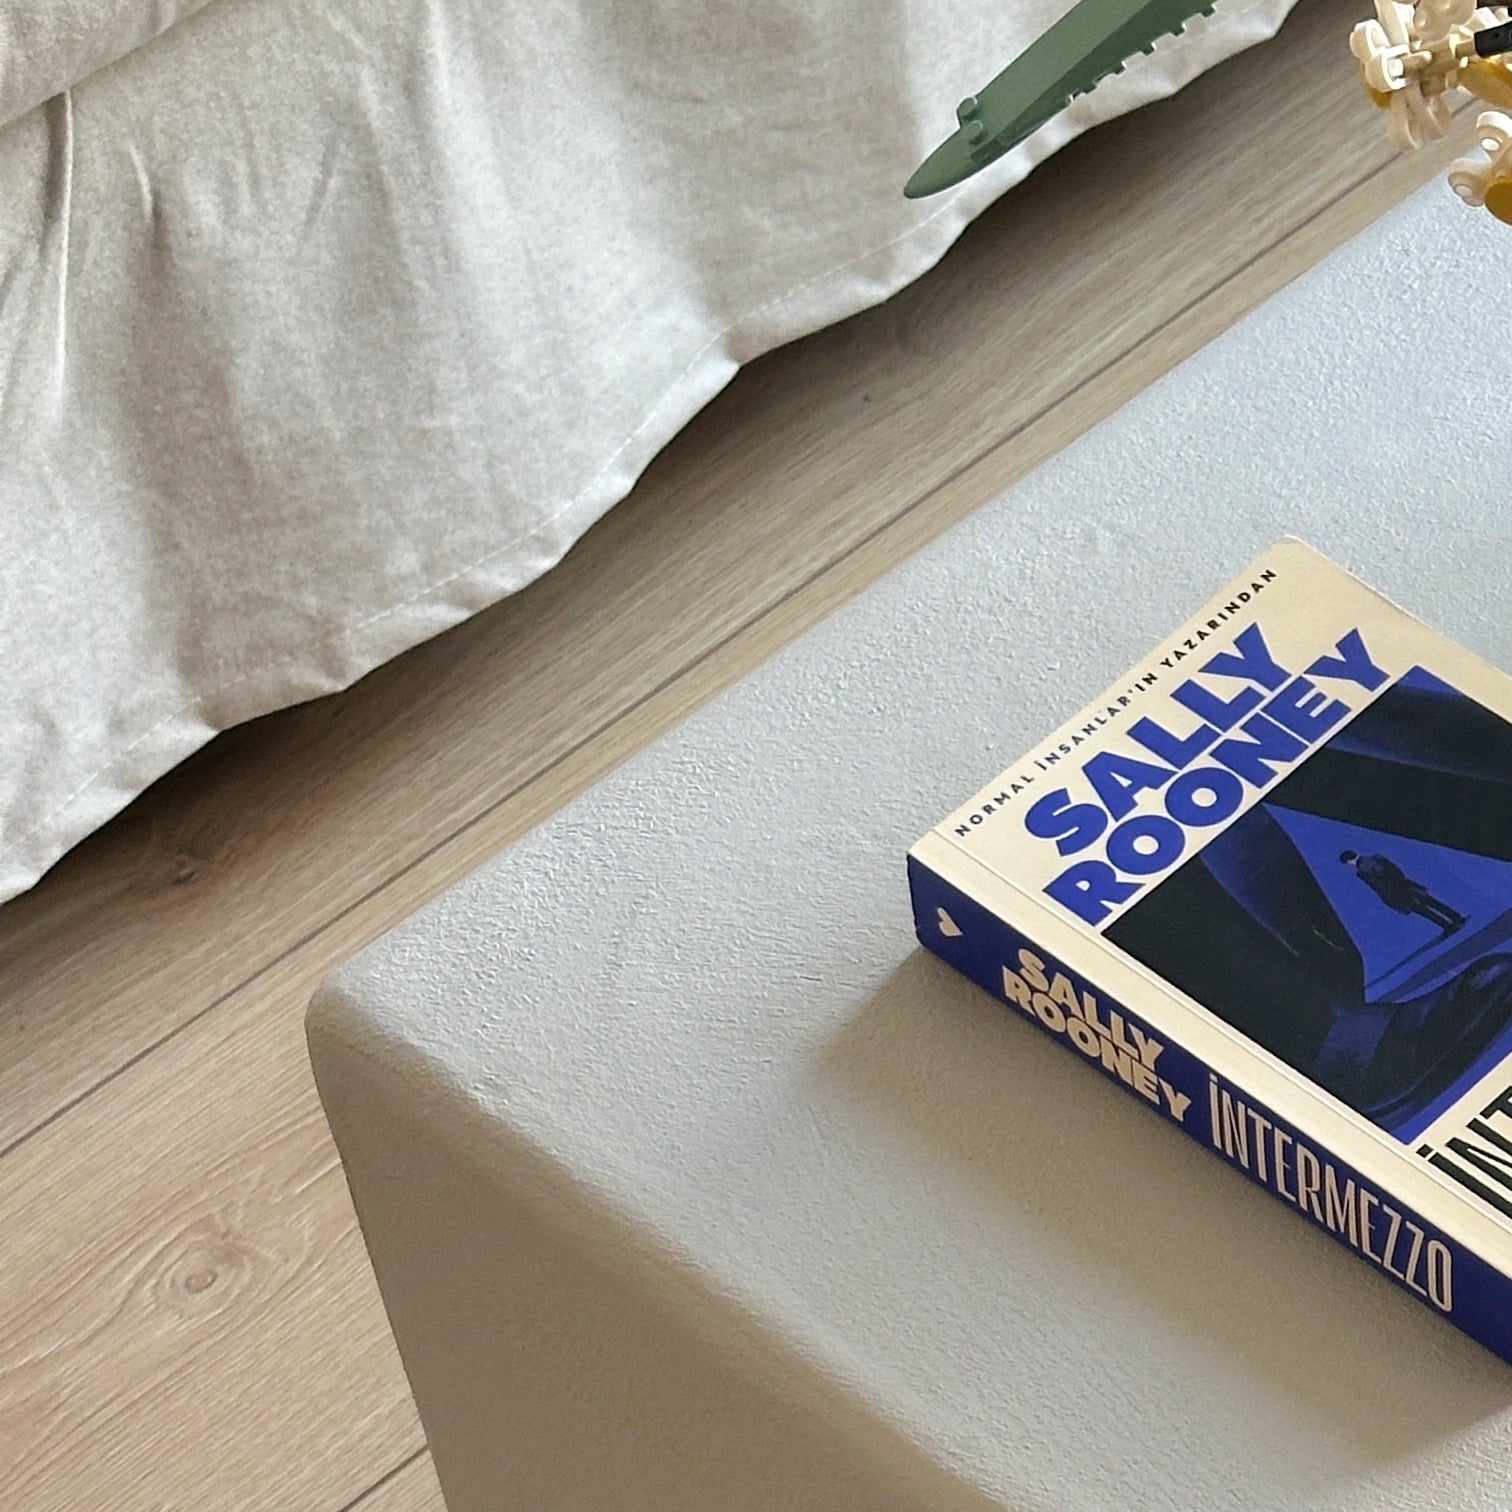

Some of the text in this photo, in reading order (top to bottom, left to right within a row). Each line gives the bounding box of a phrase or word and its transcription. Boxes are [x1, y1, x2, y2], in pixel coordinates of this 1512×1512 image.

[955, 773, 1034, 837] NORMAL
[1160, 570, 1277, 669] YAZARINDAN
[1024, 621, 1293, 857] SALLY
[1042, 628, 1391, 926] ROONEY
[1002, 965, 1192, 1122] ROONEY
[1018, 948, 1166, 1072] SALLY
[1208, 1072, 1454, 1312] İNTERMEZZO
